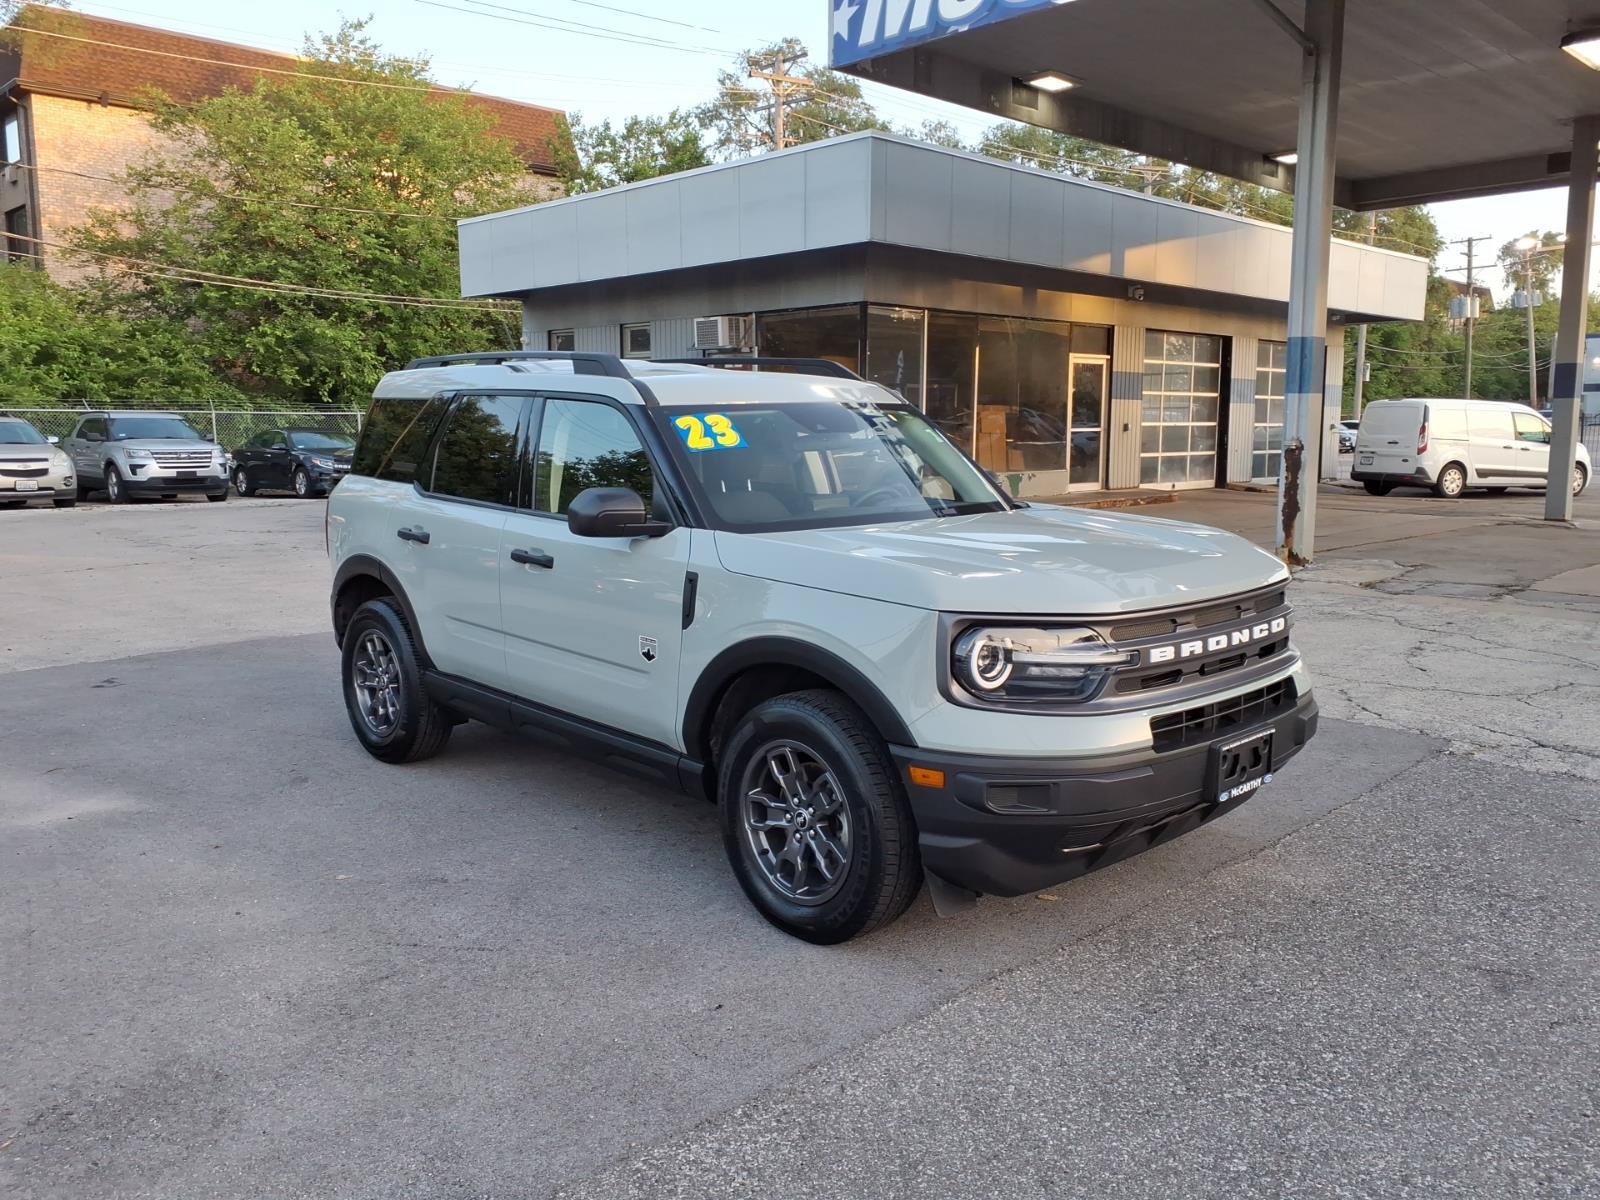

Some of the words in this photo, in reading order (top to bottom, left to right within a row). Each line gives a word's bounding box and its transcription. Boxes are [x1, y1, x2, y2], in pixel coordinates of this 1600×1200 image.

[675, 414, 740, 449] 23
[1149, 617, 1285, 663] BRONCO
[1230, 777, 1262, 798] McCARTHY
